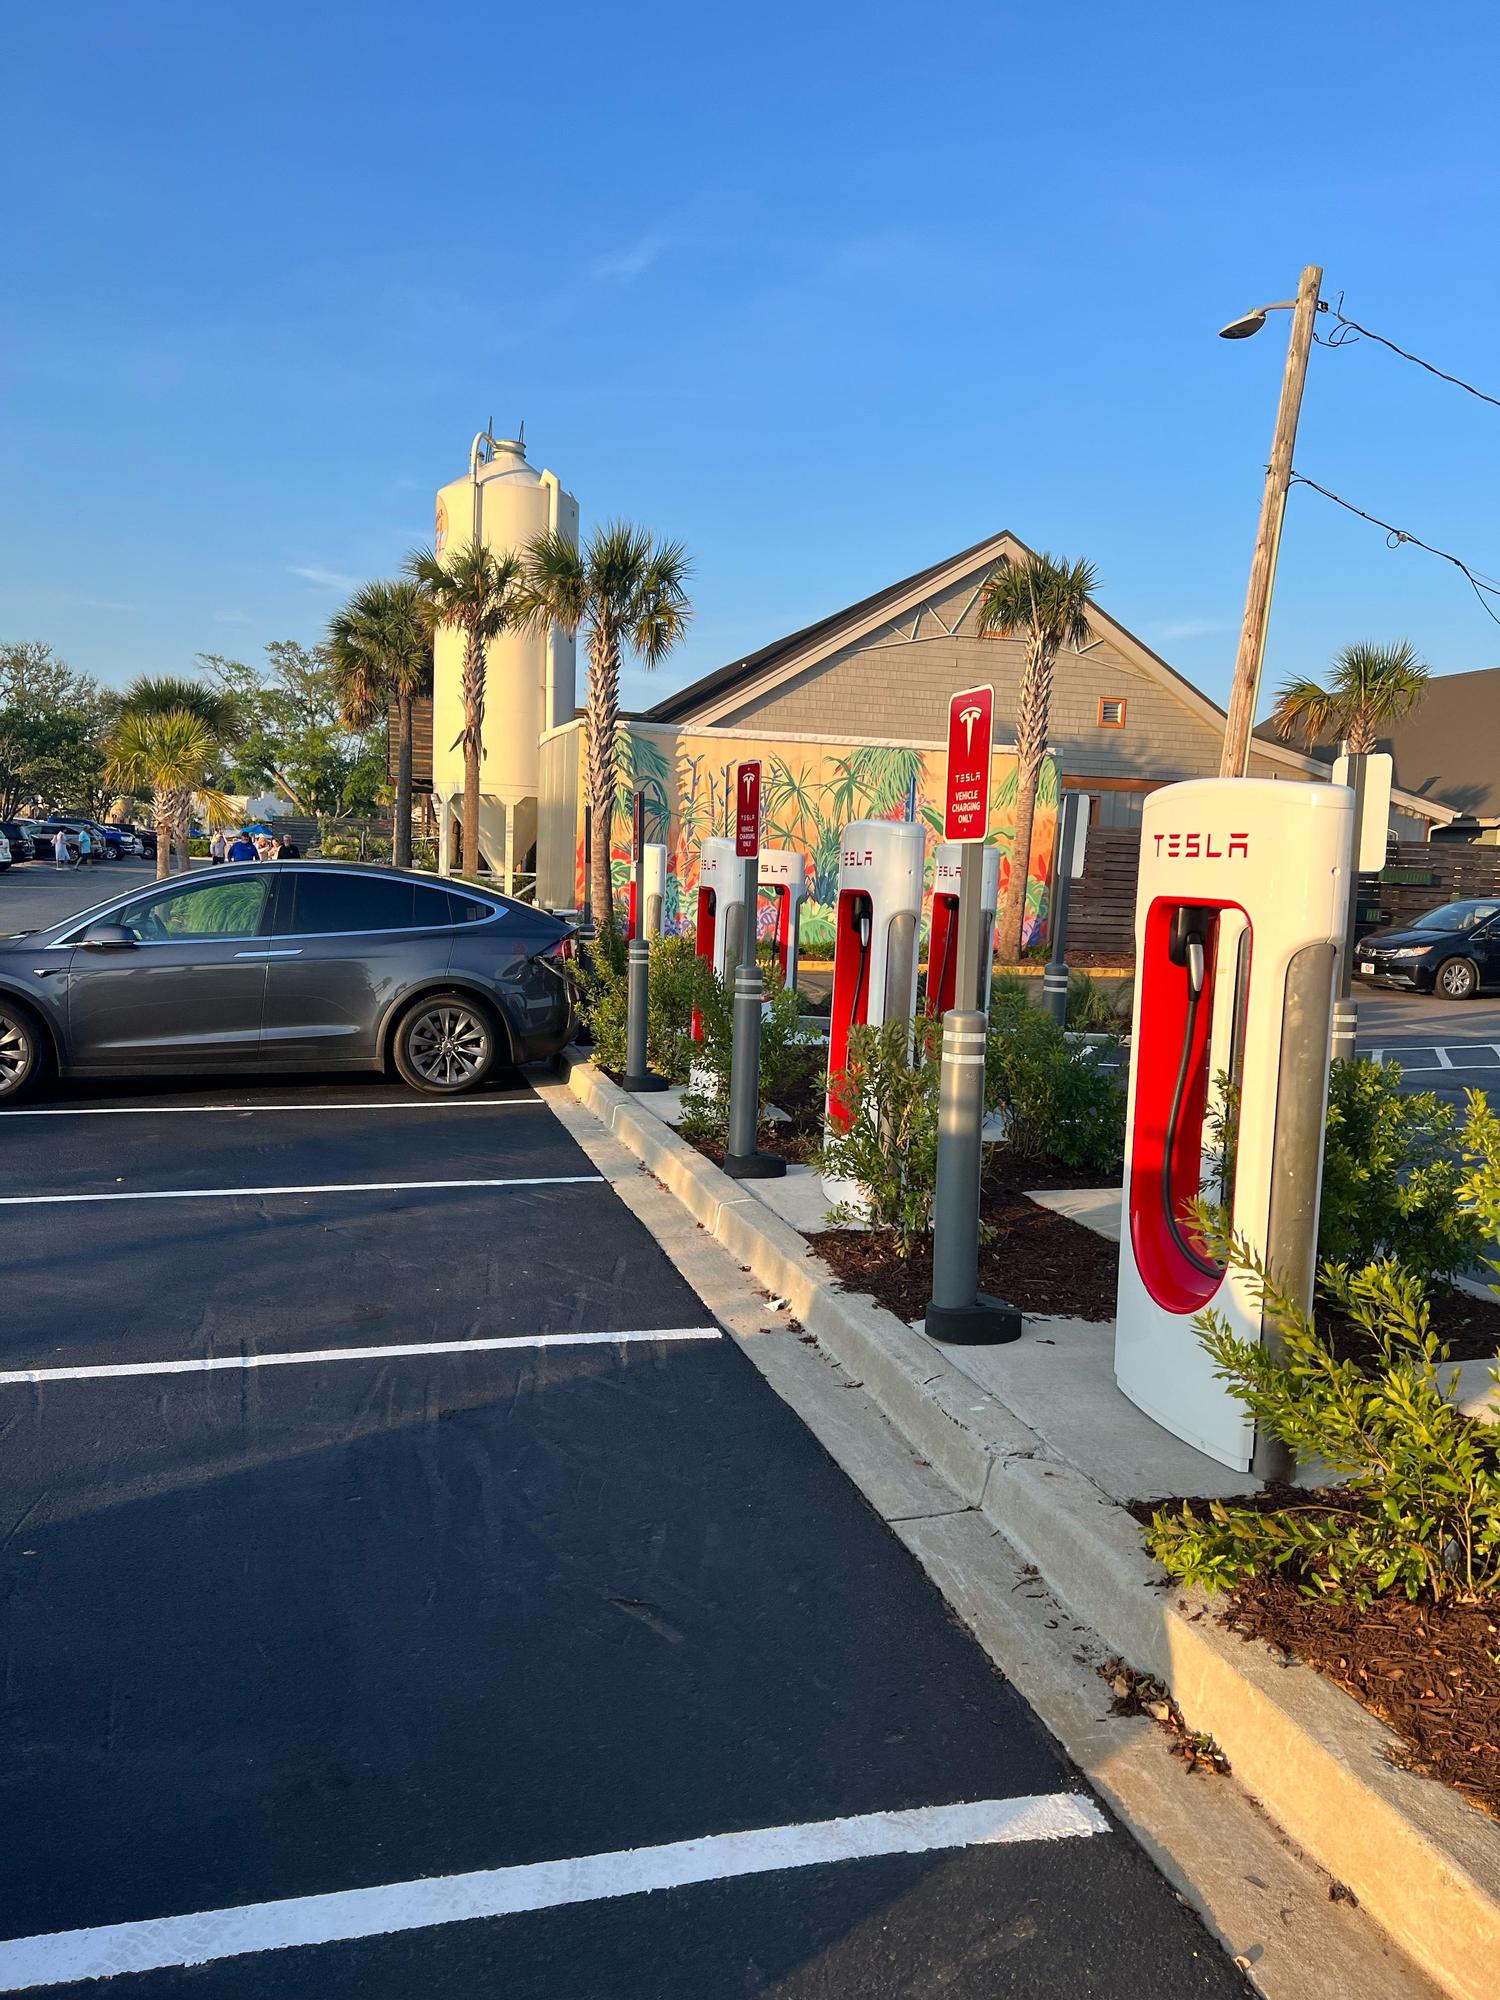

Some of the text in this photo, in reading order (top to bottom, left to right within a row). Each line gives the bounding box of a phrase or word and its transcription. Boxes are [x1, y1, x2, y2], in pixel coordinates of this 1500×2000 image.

[955, 771, 981, 783] TESLA
[955, 790, 978, 801] VEHICLE
[951, 801, 980, 813] CHARGING
[957, 814, 973, 824] ONLY
[1154, 833, 1249, 858] TESLA
[843, 851, 873, 866] ESLA
[761, 864, 788, 873] SLA
[938, 865, 961, 877] ESLA
